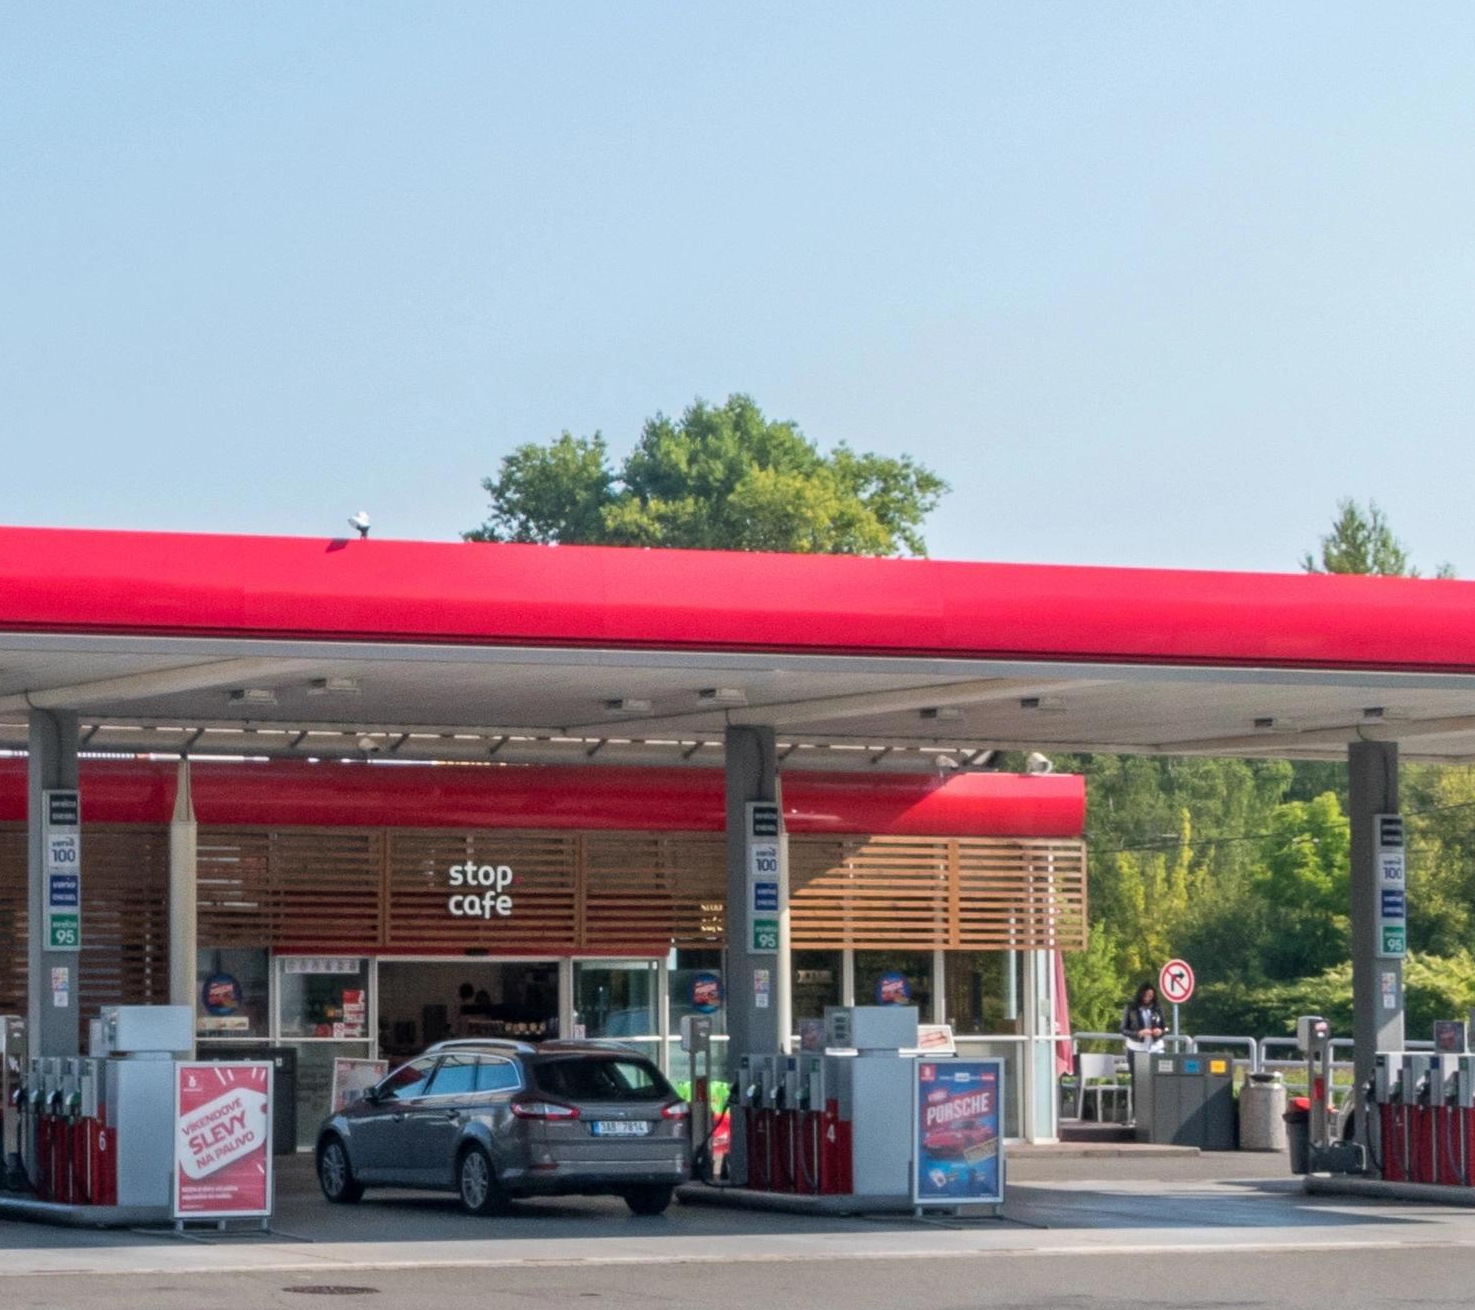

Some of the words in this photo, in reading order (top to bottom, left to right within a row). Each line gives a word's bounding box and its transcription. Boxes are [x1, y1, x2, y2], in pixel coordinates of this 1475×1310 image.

[52, 849, 76, 863] 100
[756, 858, 777, 872] 100
[449, 861, 513, 892] stop
[1383, 867, 1403, 880] 100
[449, 891, 513, 919] cafe
[55, 930, 75, 945] 95
[759, 933, 777, 948] 95
[1387, 938, 1403, 952] 95
[926, 1092, 990, 1126] PORSCHE
[188, 1110, 247, 1156] SLEVY
[826, 1124, 835, 1142] 4
